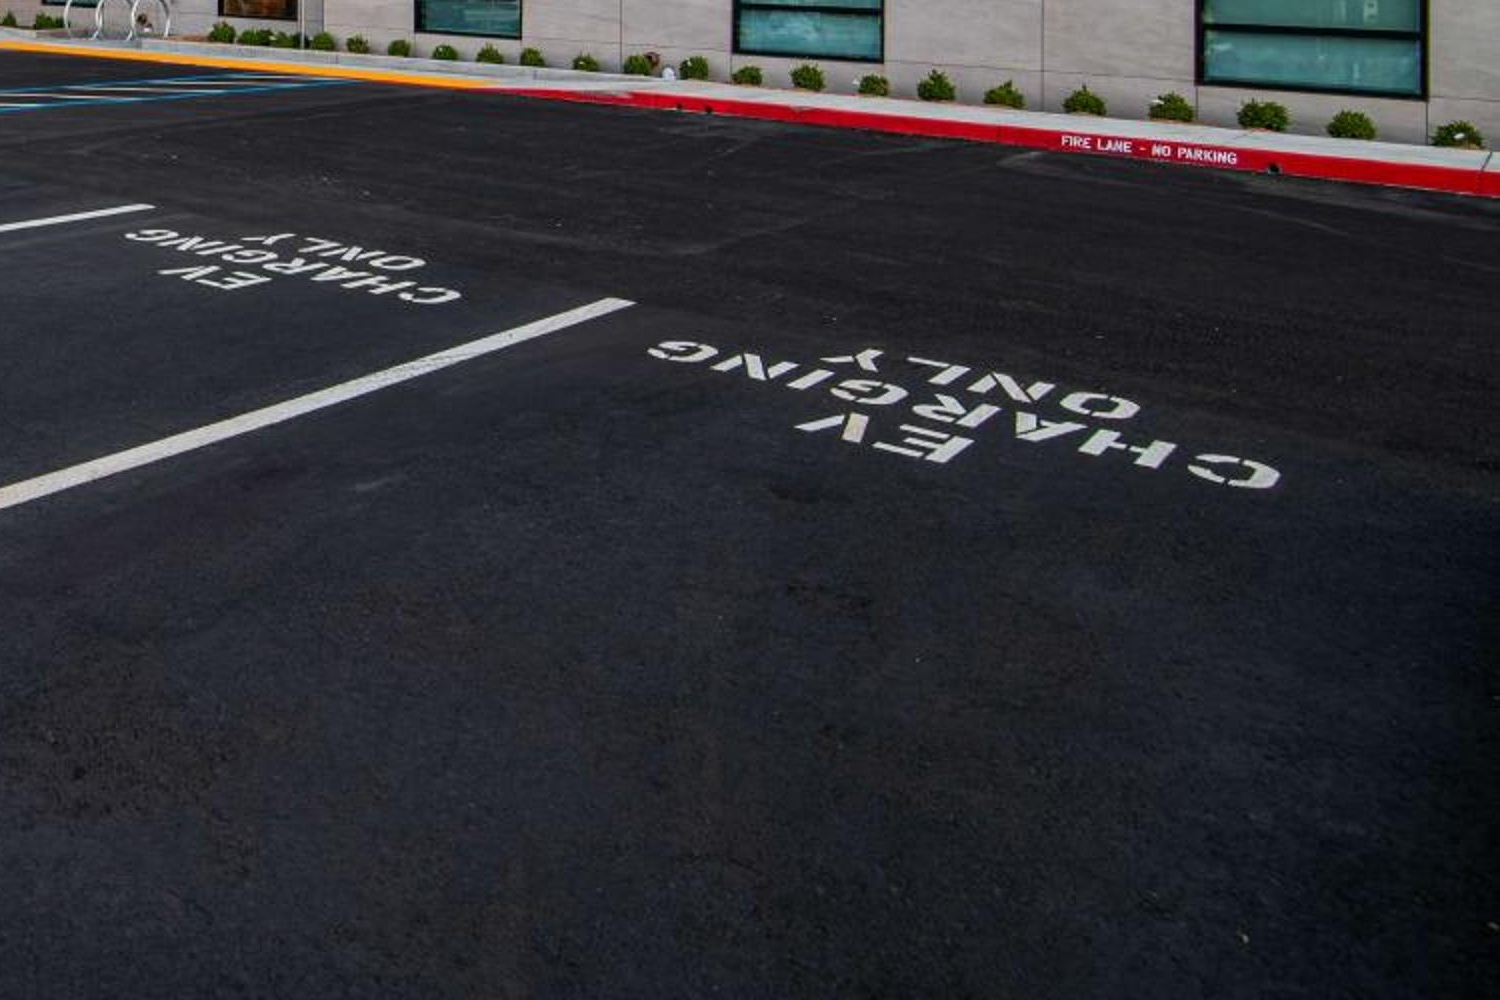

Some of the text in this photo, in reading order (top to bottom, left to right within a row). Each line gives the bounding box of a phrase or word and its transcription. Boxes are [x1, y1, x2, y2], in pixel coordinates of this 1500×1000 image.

[1061, 135, 1092, 149] FIRE
[1097, 138, 1132, 153] LANE
[1152, 144, 1172, 157] NO
[1177, 147, 1238, 165] PARKING
[124, 229, 461, 303] CHARGING
[241, 233, 426, 271] ONLY
[158, 265, 272, 290] EV
[820, 349, 1140, 420] ONLY
[647, 341, 1281, 489] CHARGING
[794, 413, 975, 463] EV
